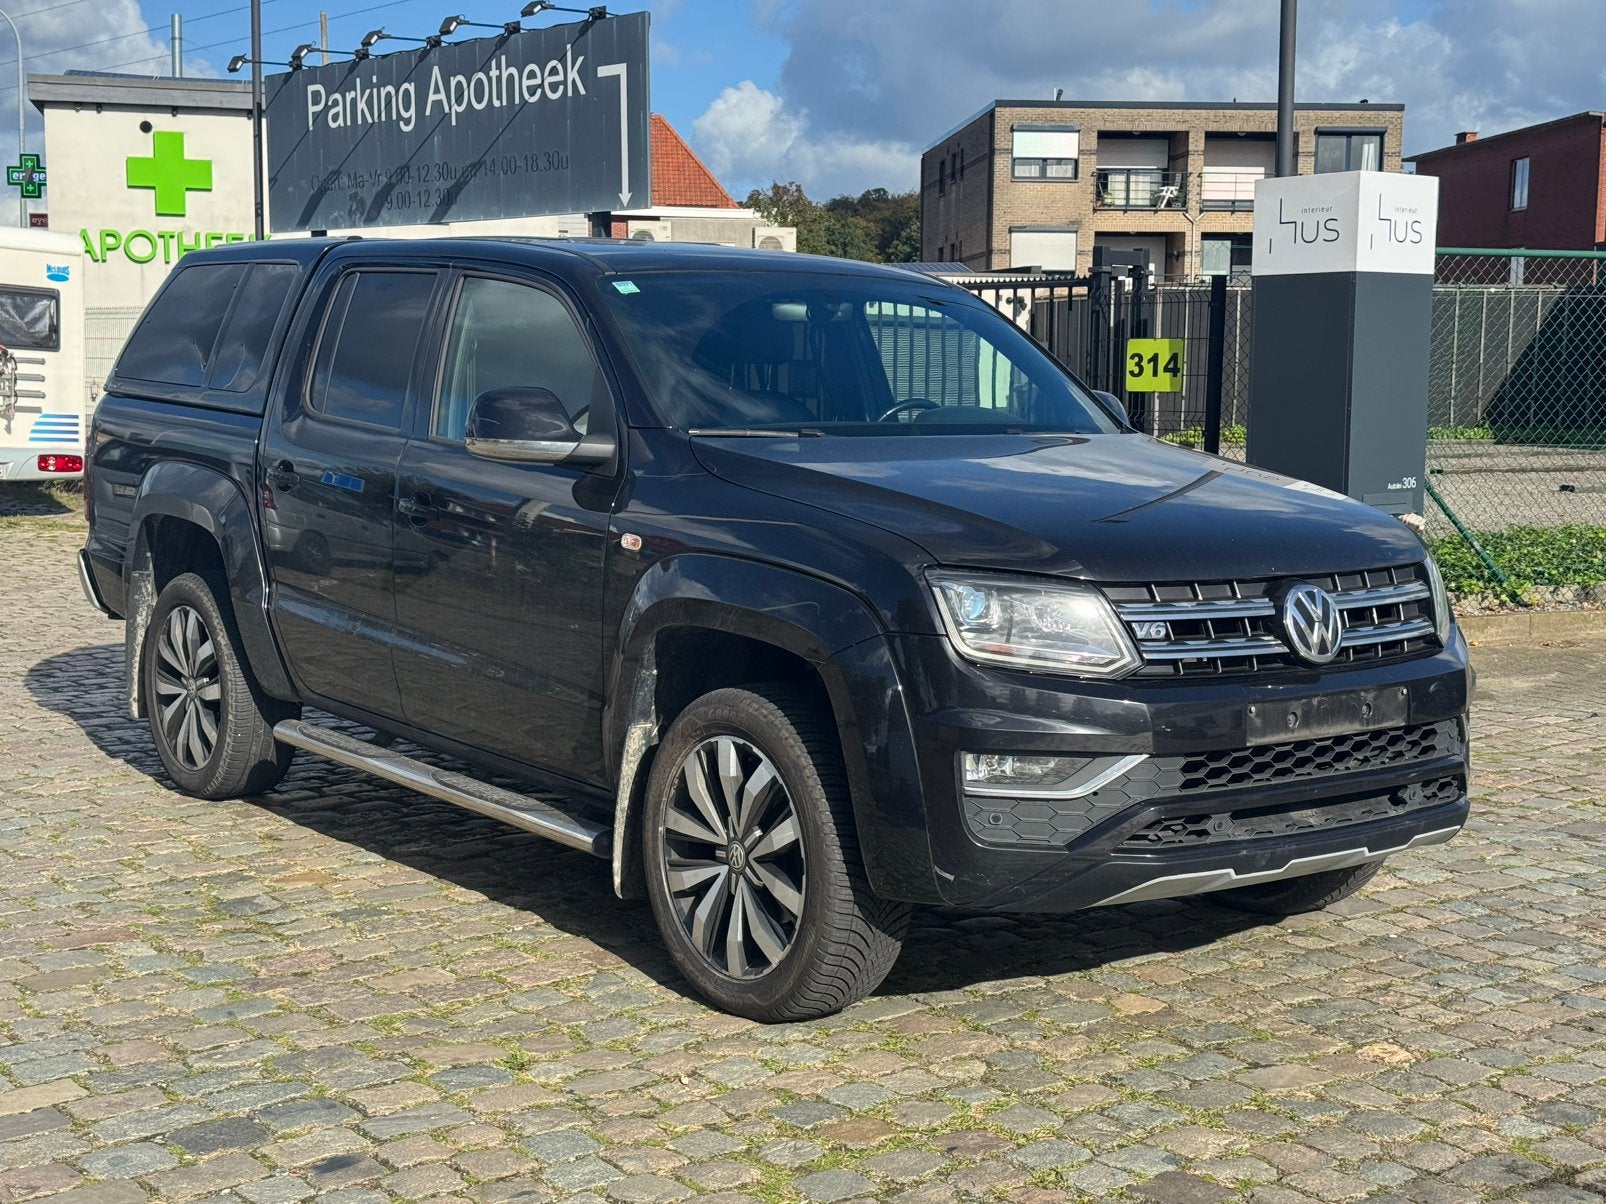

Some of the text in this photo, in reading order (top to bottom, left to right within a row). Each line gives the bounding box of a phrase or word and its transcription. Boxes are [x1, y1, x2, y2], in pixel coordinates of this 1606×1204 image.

[306, 43, 587, 132] Parking Apotheek
[347, 169, 383, 190] Ma-Vr
[482, 150, 569, 177] 14.00-18.30u
[1300, 205, 1333, 214] interieur
[79, 228, 272, 264] APOTH
[1128, 352, 1181, 378] 314
[1402, 476, 1417, 489] 306
[1131, 621, 1167, 640] V6
